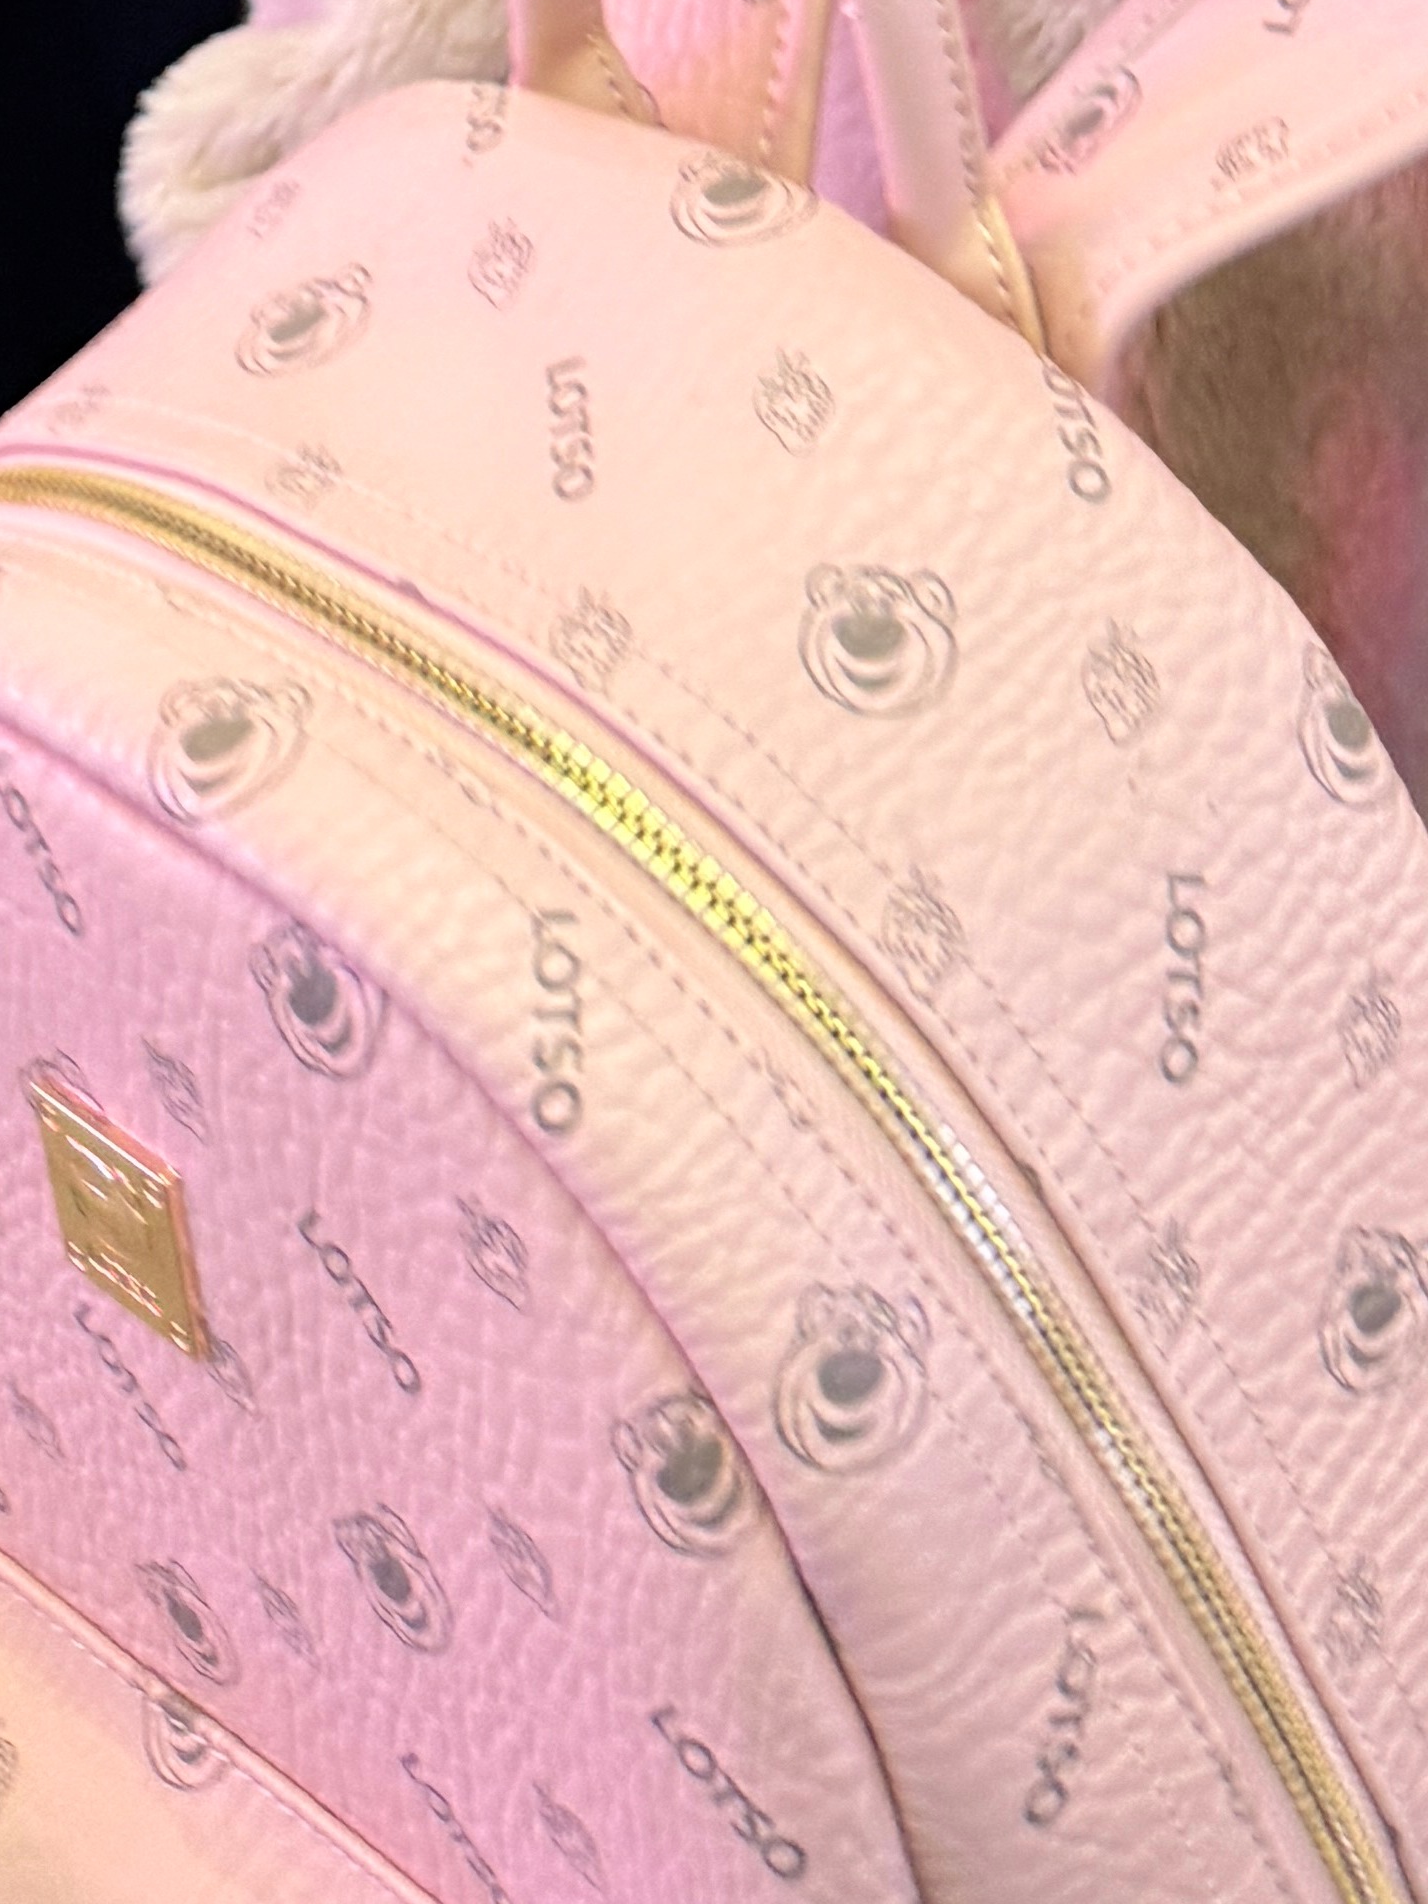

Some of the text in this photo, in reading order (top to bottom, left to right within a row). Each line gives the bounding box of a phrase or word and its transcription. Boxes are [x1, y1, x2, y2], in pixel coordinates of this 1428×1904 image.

[545, 355, 594, 502] LOTSO
[1043, 360, 1112, 503] OTSO
[532, 908, 581, 1135] LOTSO
[1161, 871, 1208, 1084] LOTSO
[297, 1208, 421, 1393] LOTSO
[649, 1706, 807, 1880] LOTSO
[1023, 1608, 1101, 1828] LOTSO
